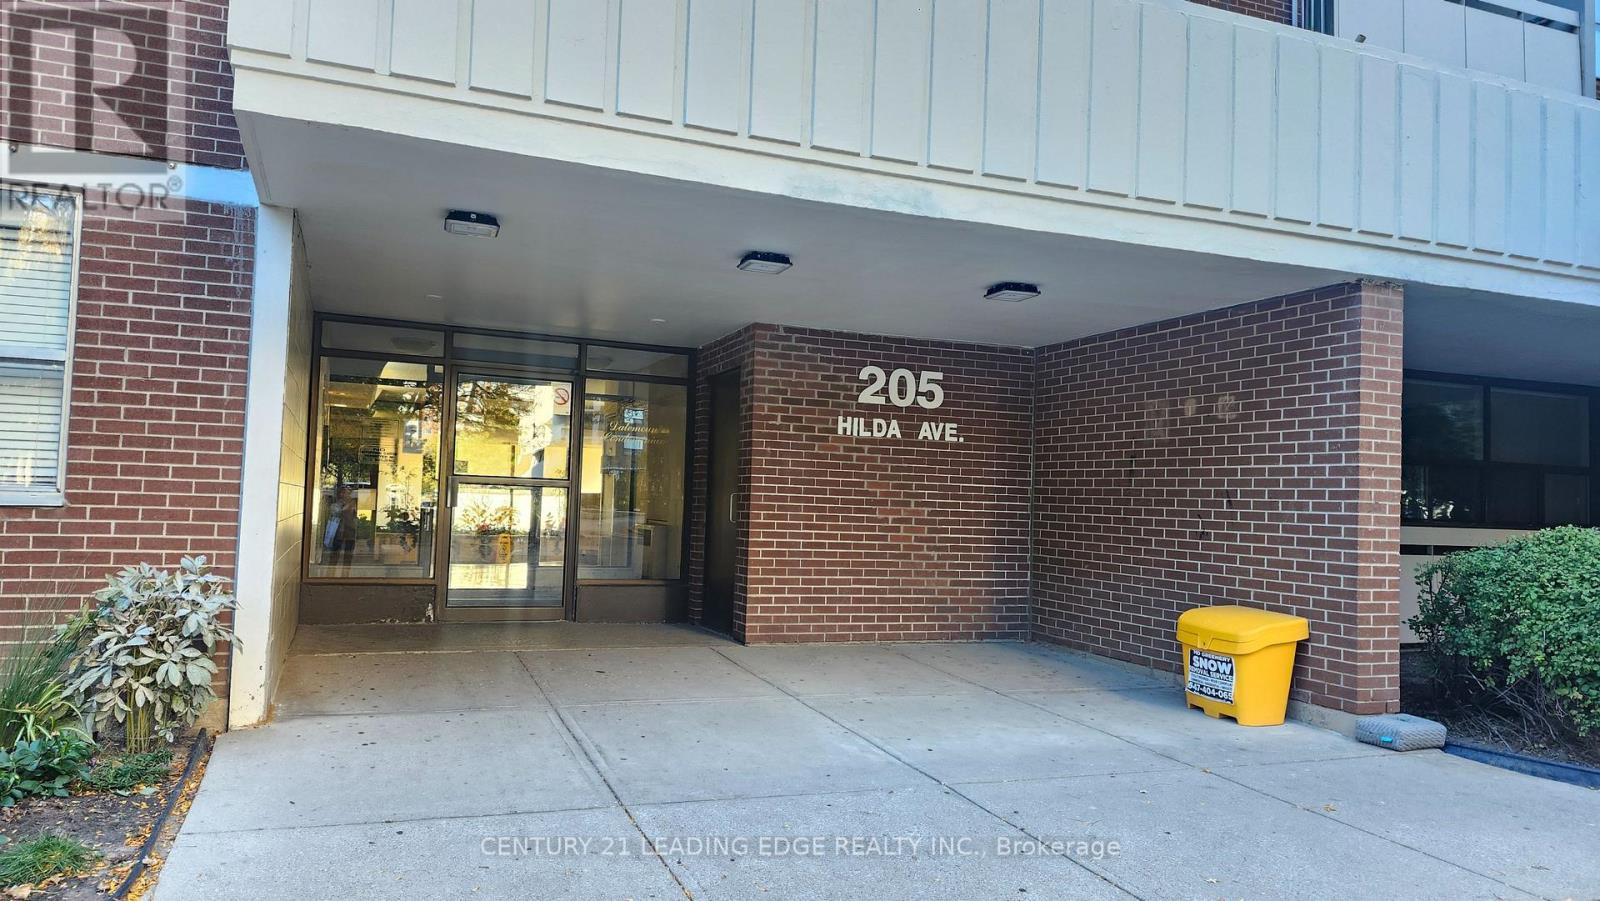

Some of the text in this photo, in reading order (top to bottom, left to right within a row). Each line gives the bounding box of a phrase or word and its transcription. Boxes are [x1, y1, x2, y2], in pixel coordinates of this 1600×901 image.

[857, 365, 945, 409] 205
[837, 415, 965, 443] HILDA AVE.
[1192, 655, 1232, 675] SNOW
[1210, 671, 1233, 682] SERVICE
